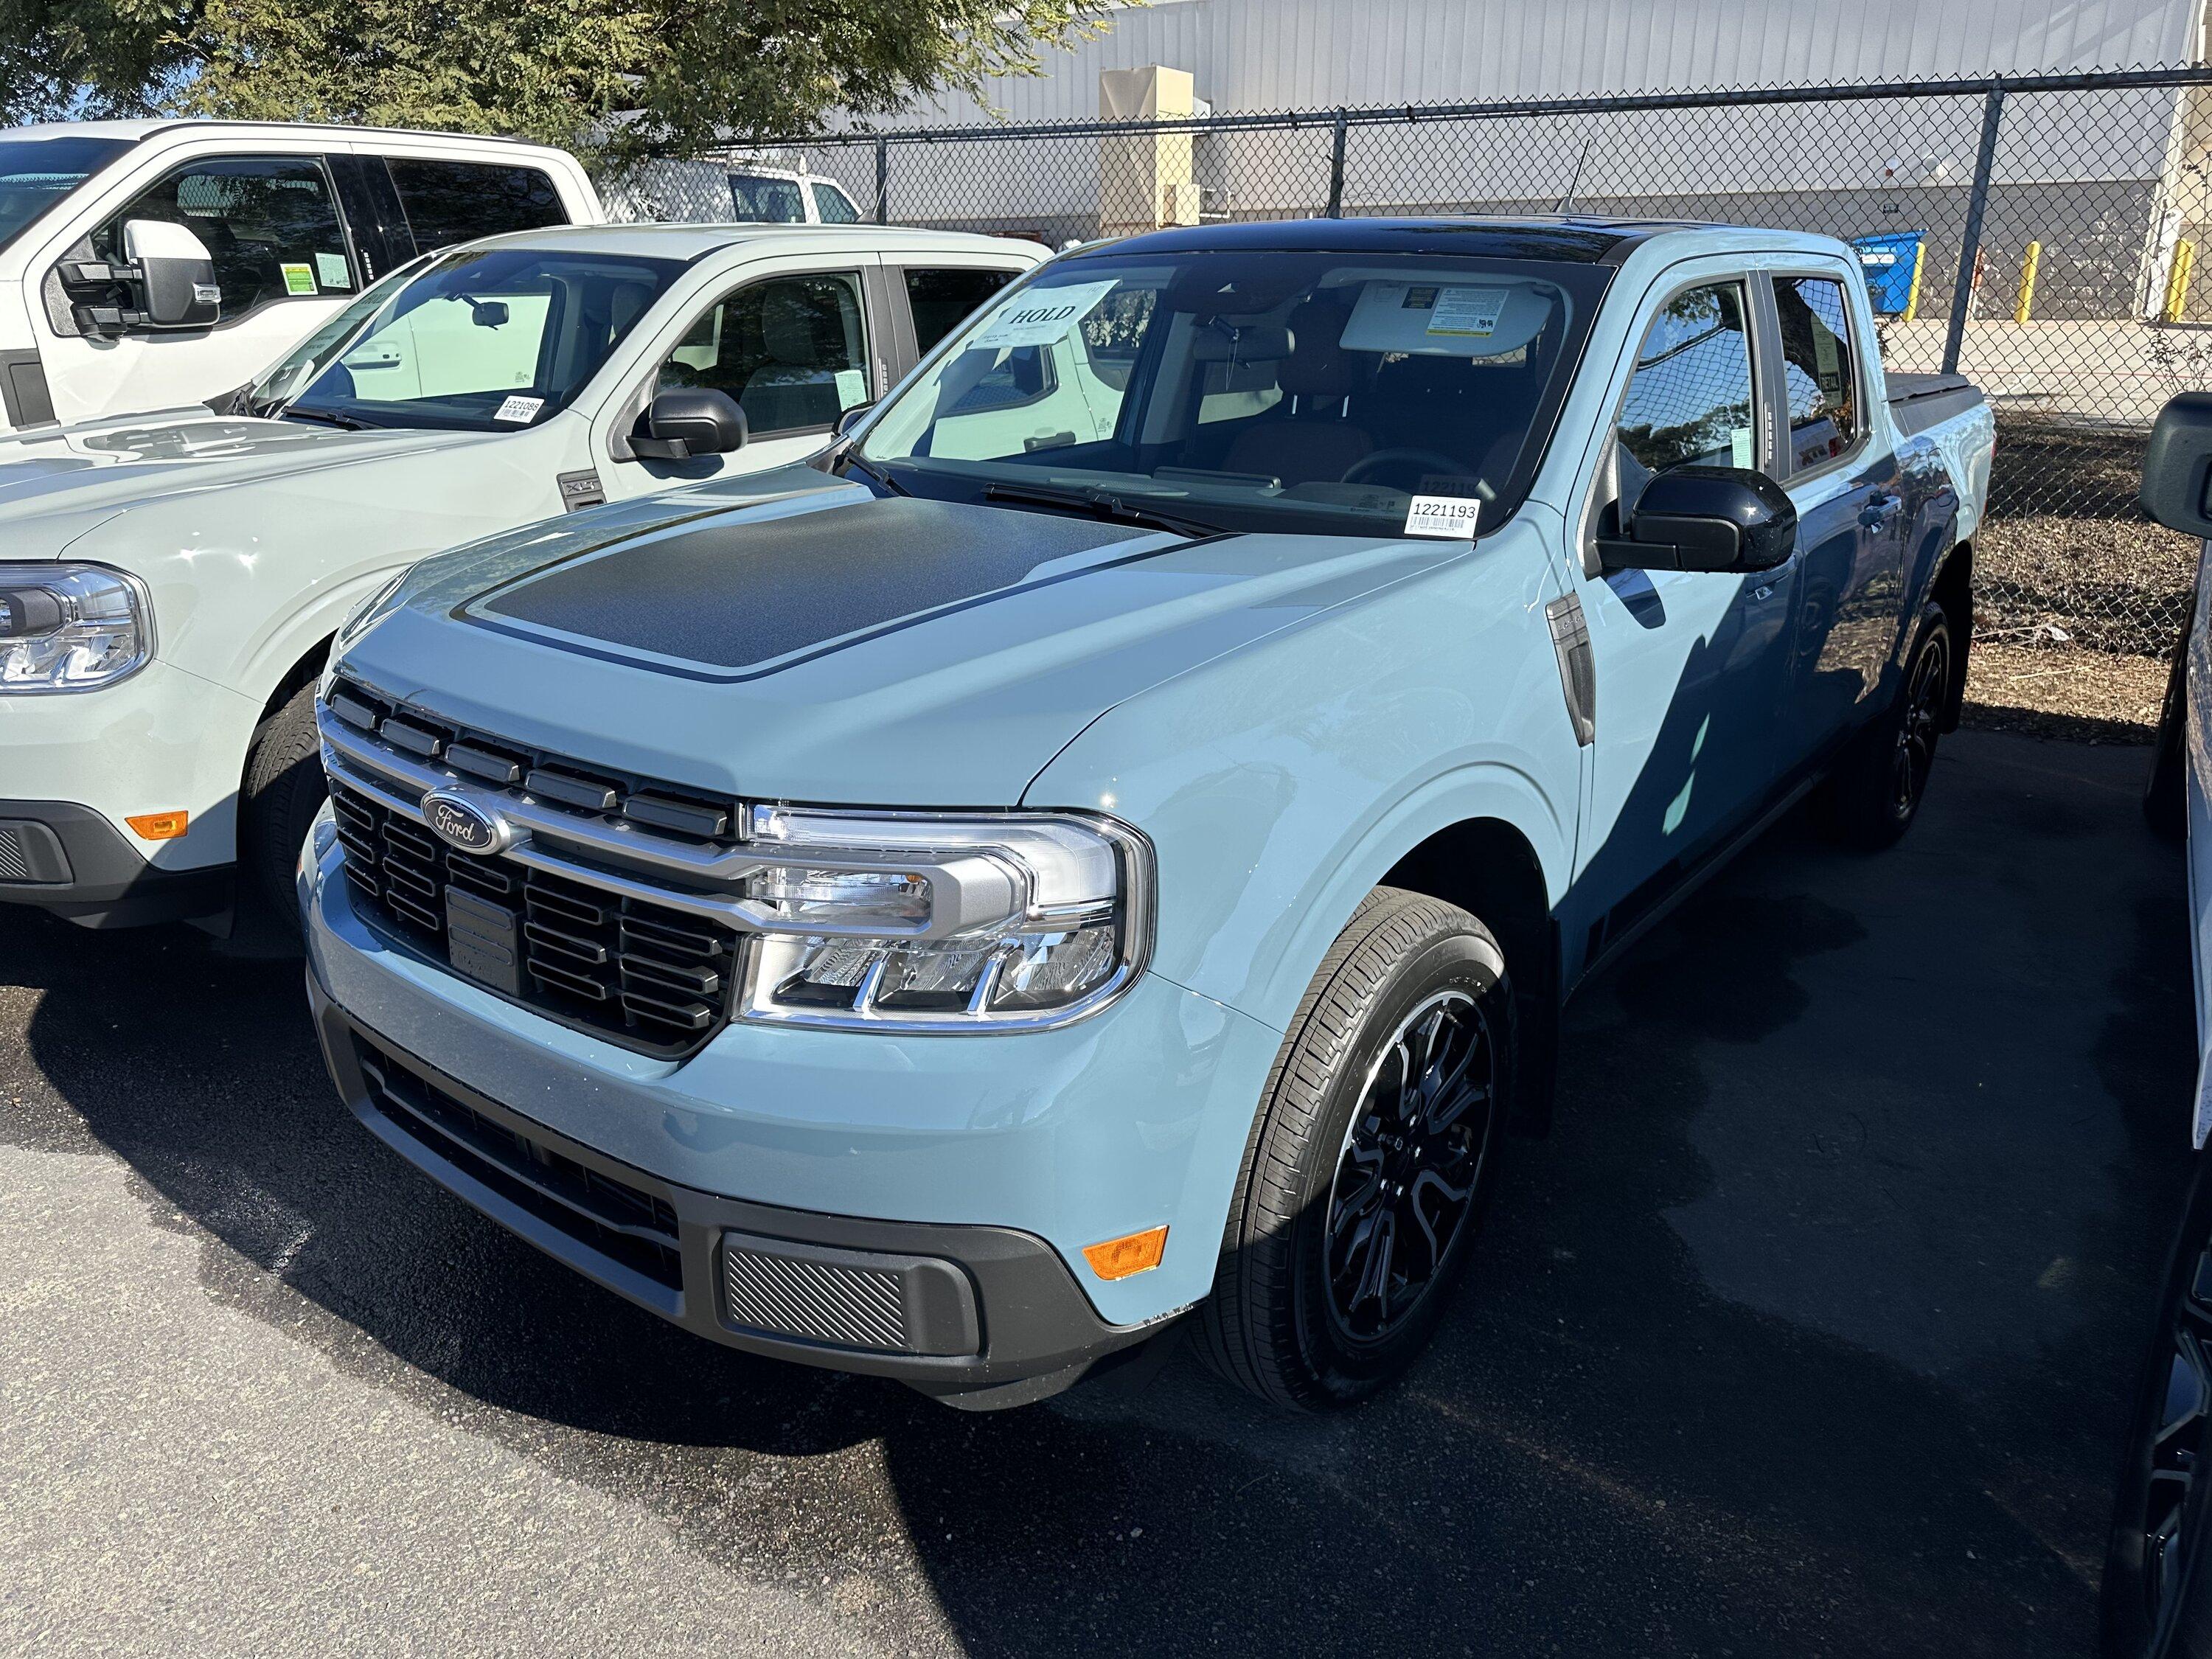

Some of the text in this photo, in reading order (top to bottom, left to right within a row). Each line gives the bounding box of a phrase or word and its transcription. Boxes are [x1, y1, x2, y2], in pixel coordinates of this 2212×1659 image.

[1008, 306, 1076, 324] HOLD
[1413, 503, 1475, 518] 1221193
[435, 804, 475, 842] Ford
